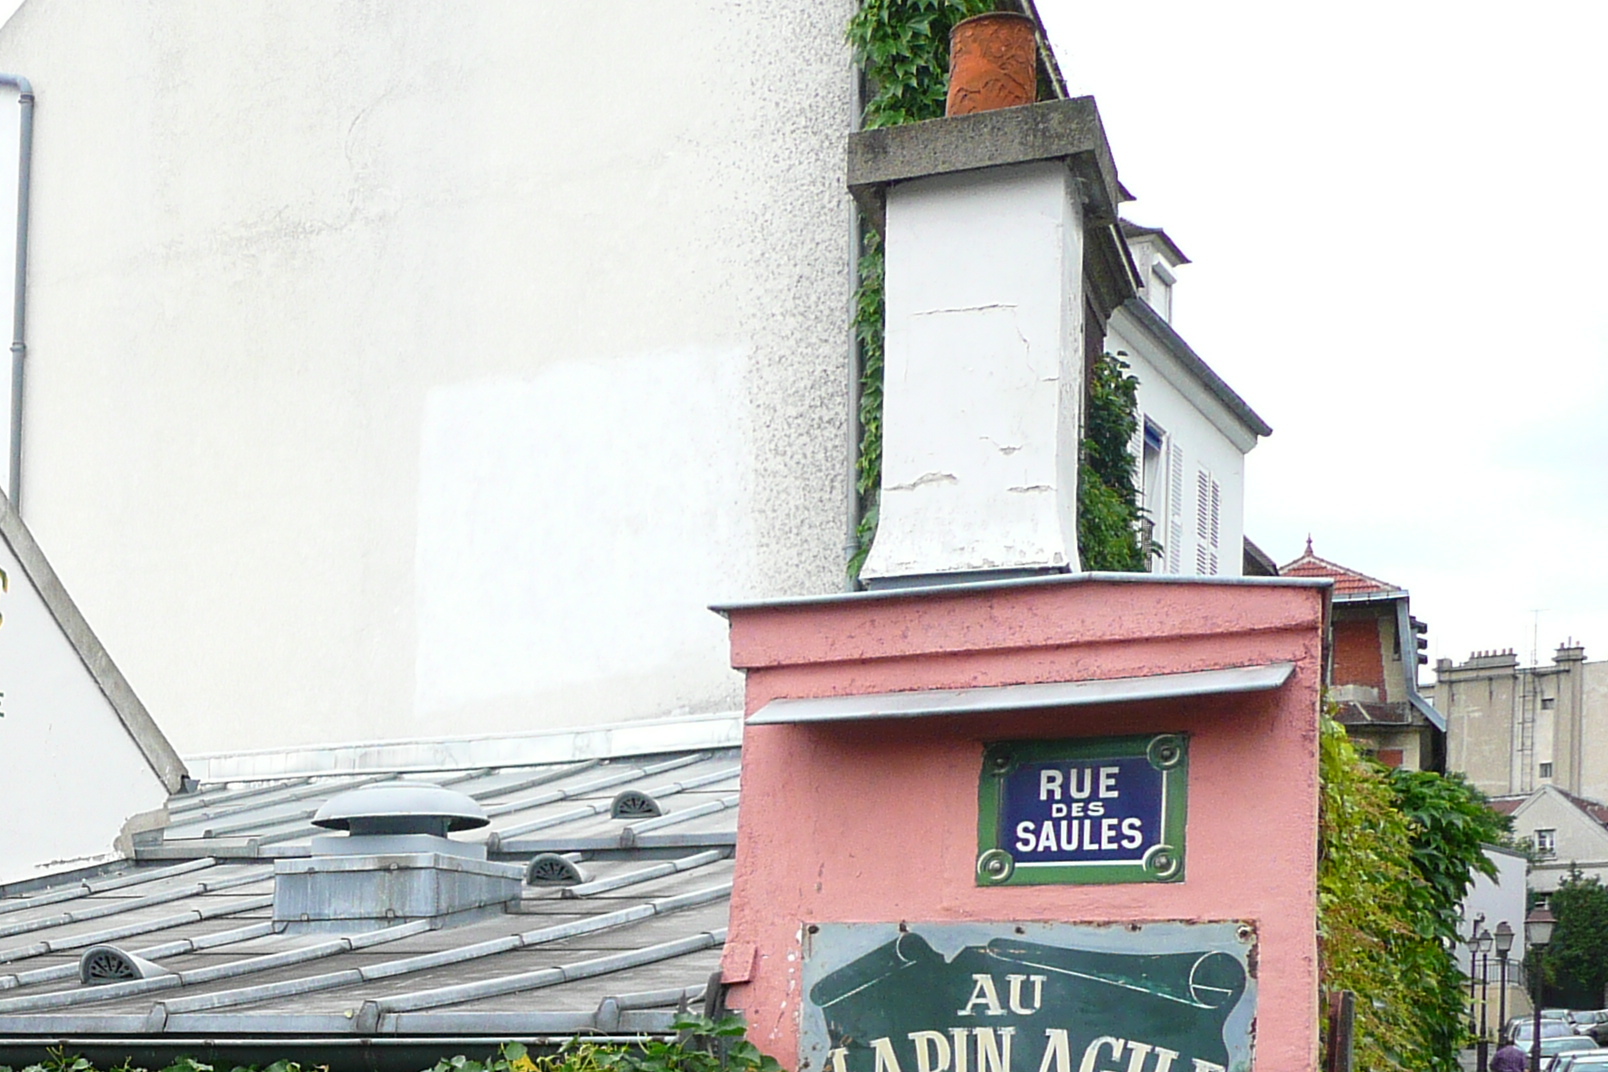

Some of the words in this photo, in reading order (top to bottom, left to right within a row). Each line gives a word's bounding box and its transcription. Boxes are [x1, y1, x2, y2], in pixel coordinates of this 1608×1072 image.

[1039, 766, 1120, 801] RUE
[1051, 801, 1105, 818] DES
[1015, 817, 1143, 852] SAULES
[957, 973, 1047, 1016] AU
